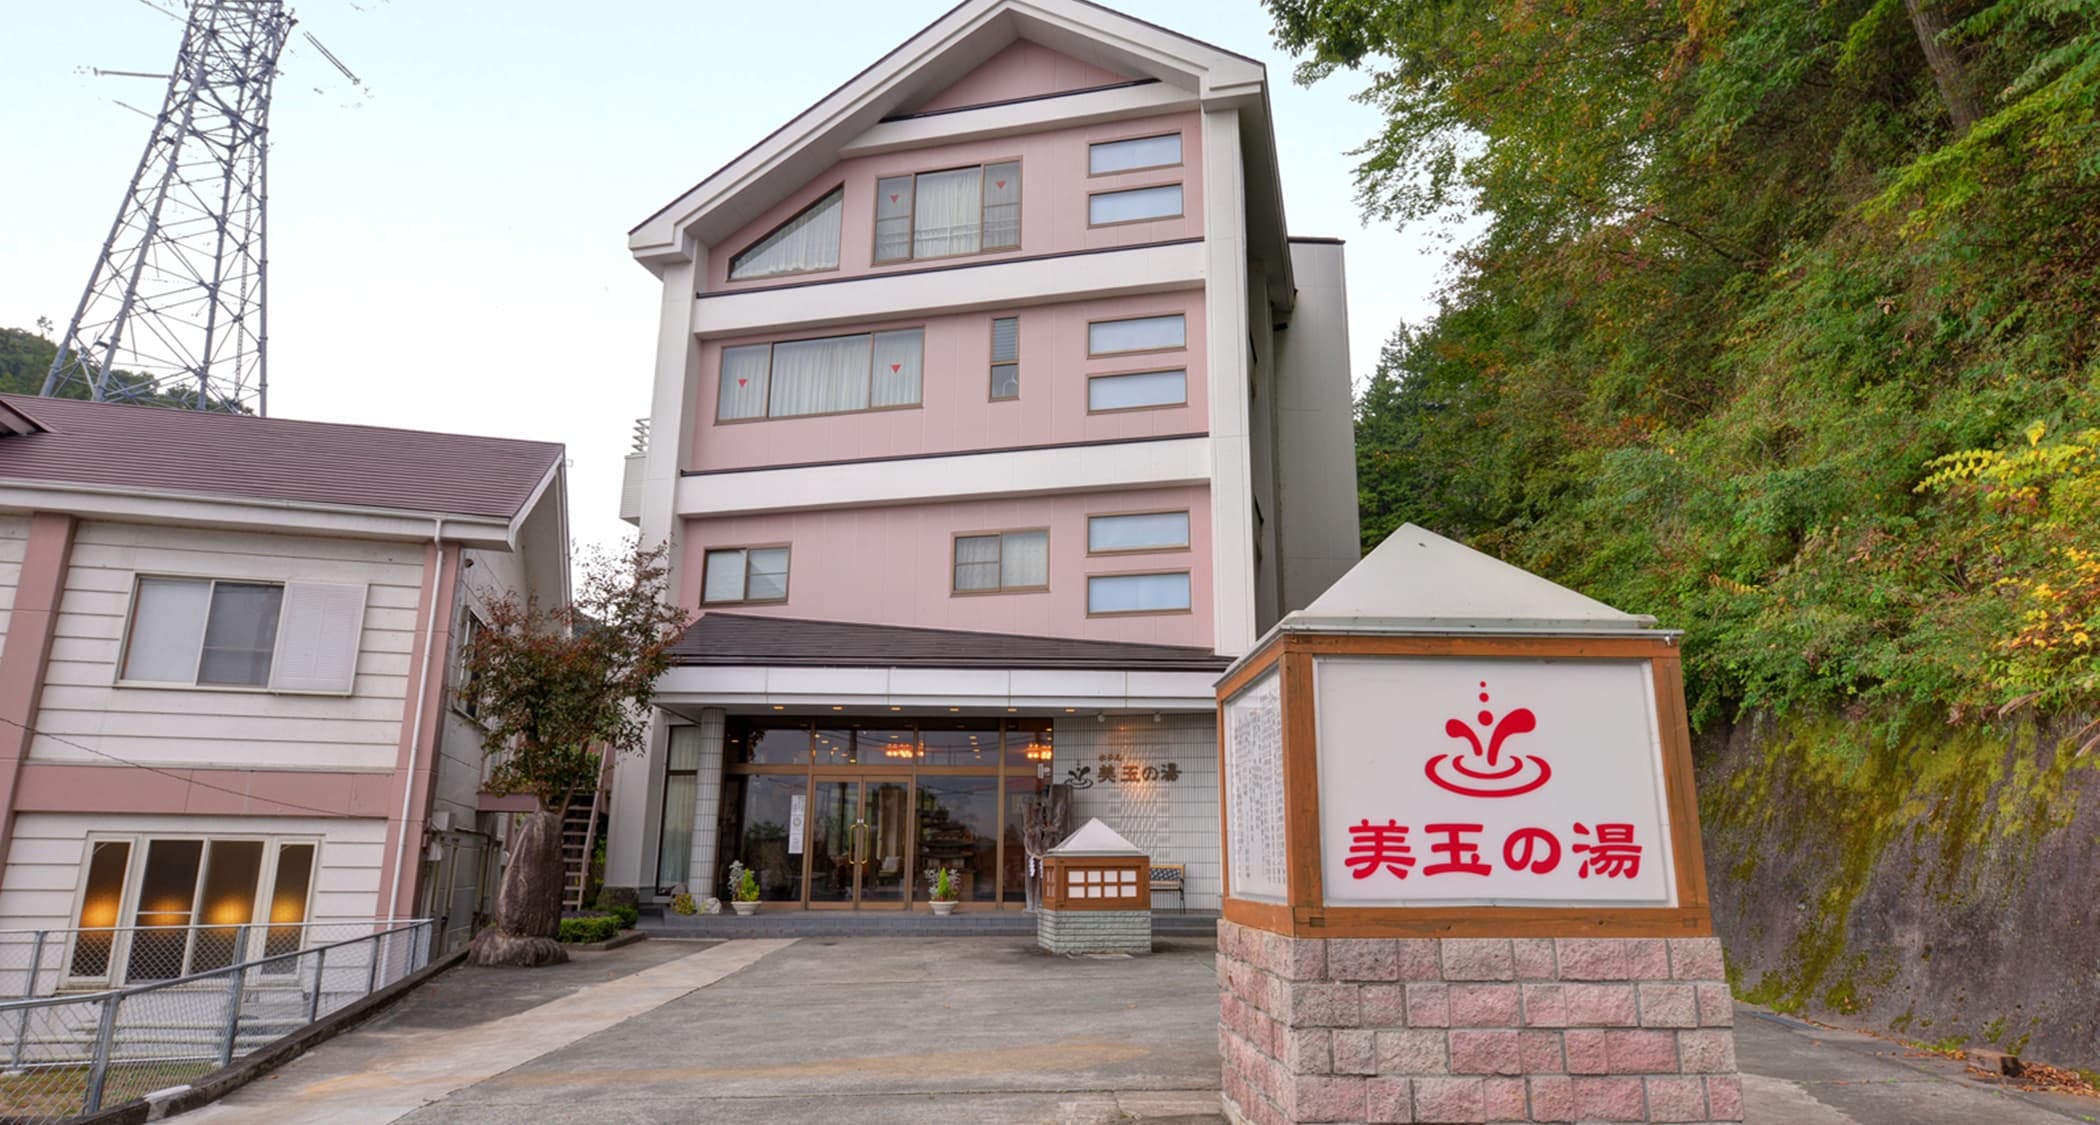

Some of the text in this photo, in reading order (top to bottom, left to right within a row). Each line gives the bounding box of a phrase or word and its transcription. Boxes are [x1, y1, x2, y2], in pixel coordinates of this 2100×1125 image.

[1097, 762, 1182, 783] 美玉の湯
[1344, 818, 1643, 880] 美玉の湯
